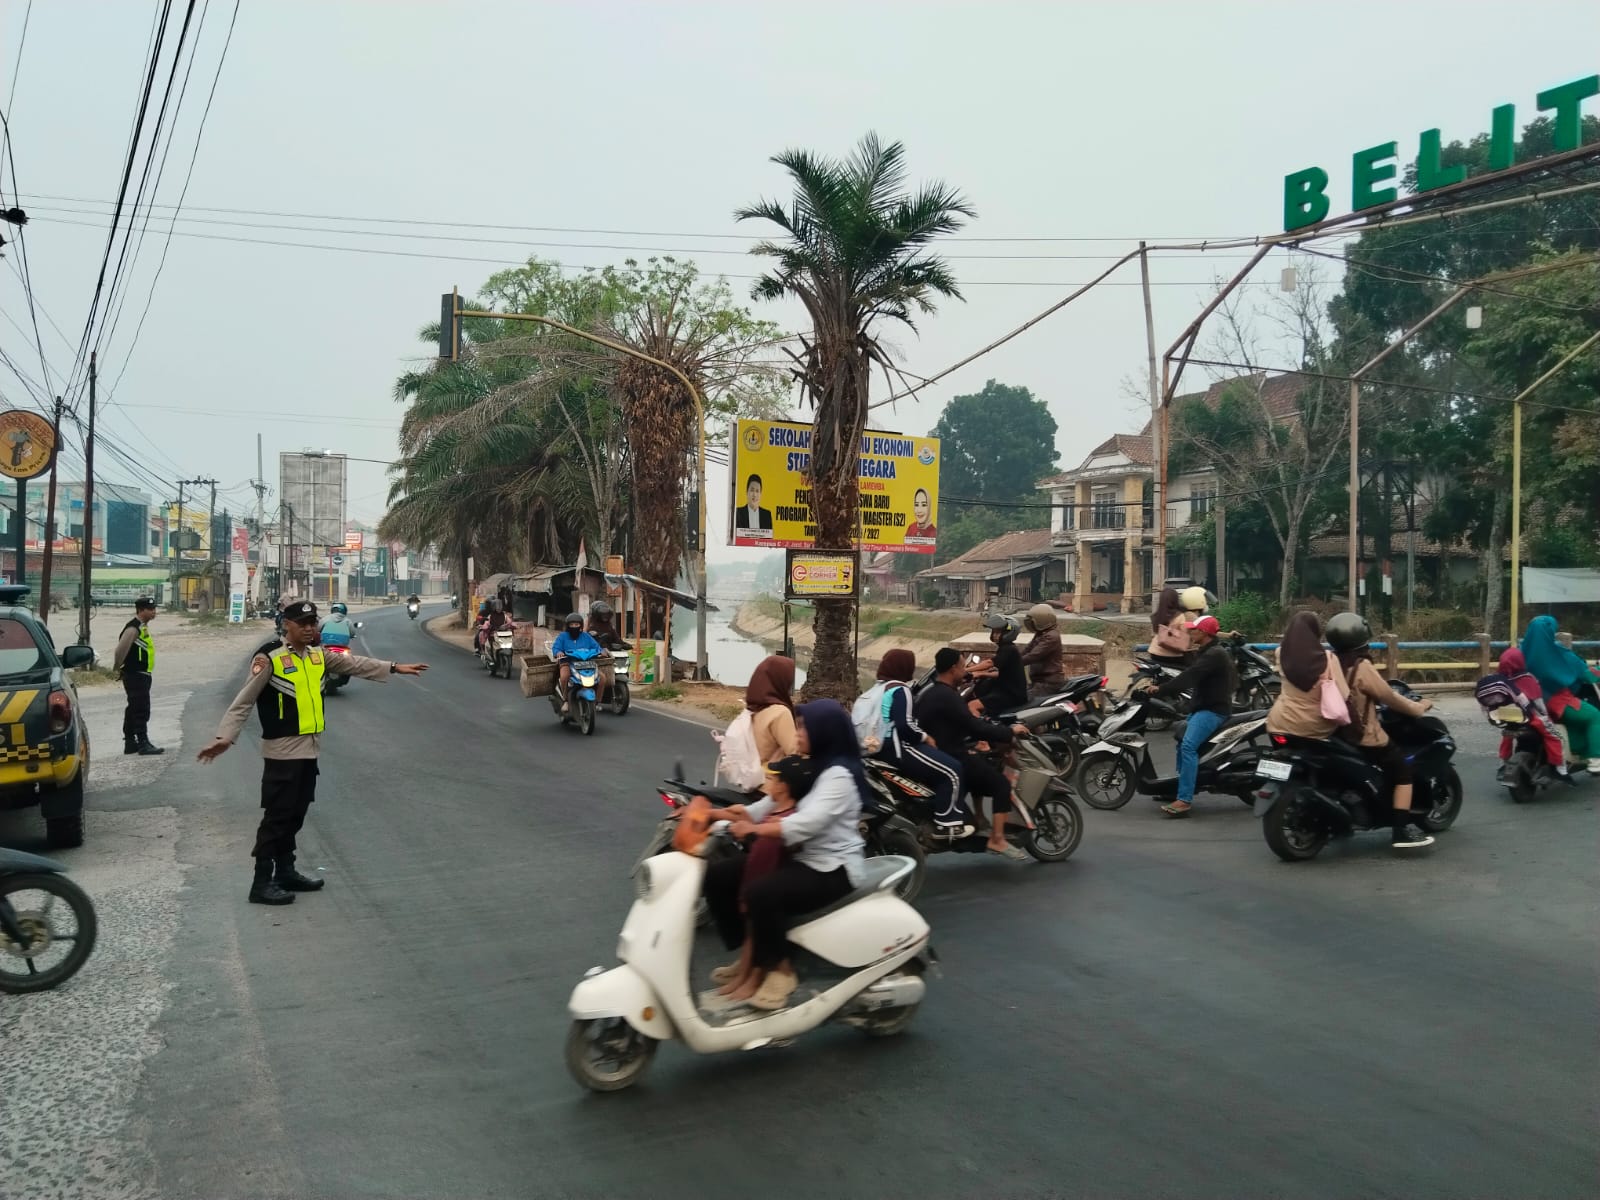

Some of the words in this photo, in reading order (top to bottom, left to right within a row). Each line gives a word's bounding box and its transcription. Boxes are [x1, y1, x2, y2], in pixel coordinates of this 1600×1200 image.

[873, 440, 914, 458] EKONOMI
[873, 494, 890, 510] BARU
[776, 506, 808, 522] PROGRAM
[863, 511, 892, 527] MAGISTER
